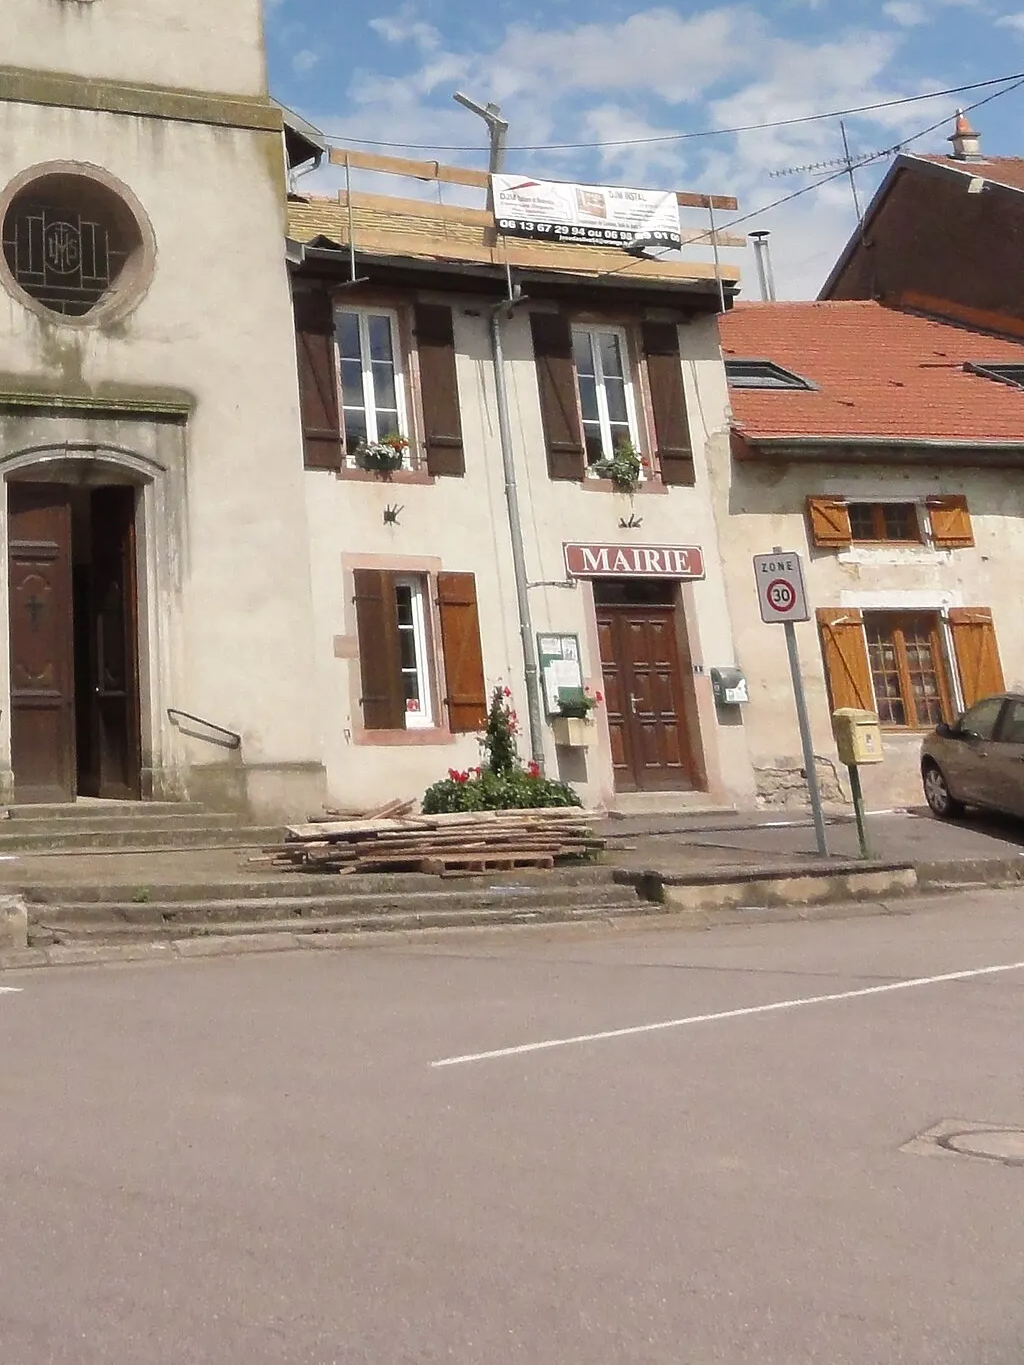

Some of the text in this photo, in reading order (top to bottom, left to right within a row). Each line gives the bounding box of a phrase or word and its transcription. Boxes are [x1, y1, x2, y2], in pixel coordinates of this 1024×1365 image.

[499, 219, 516, 229] 06
[519, 221, 534, 231] 13
[537, 223, 552, 233] 67
[554, 225, 569, 235] 29
[571, 226, 586, 236] 94
[588, 229, 603, 238] ou
[604, 230, 618, 239] 06
[580, 547, 691, 573] MAIRIE
[761, 560, 794, 573] ZONE
[772, 588, 790, 602] 30
